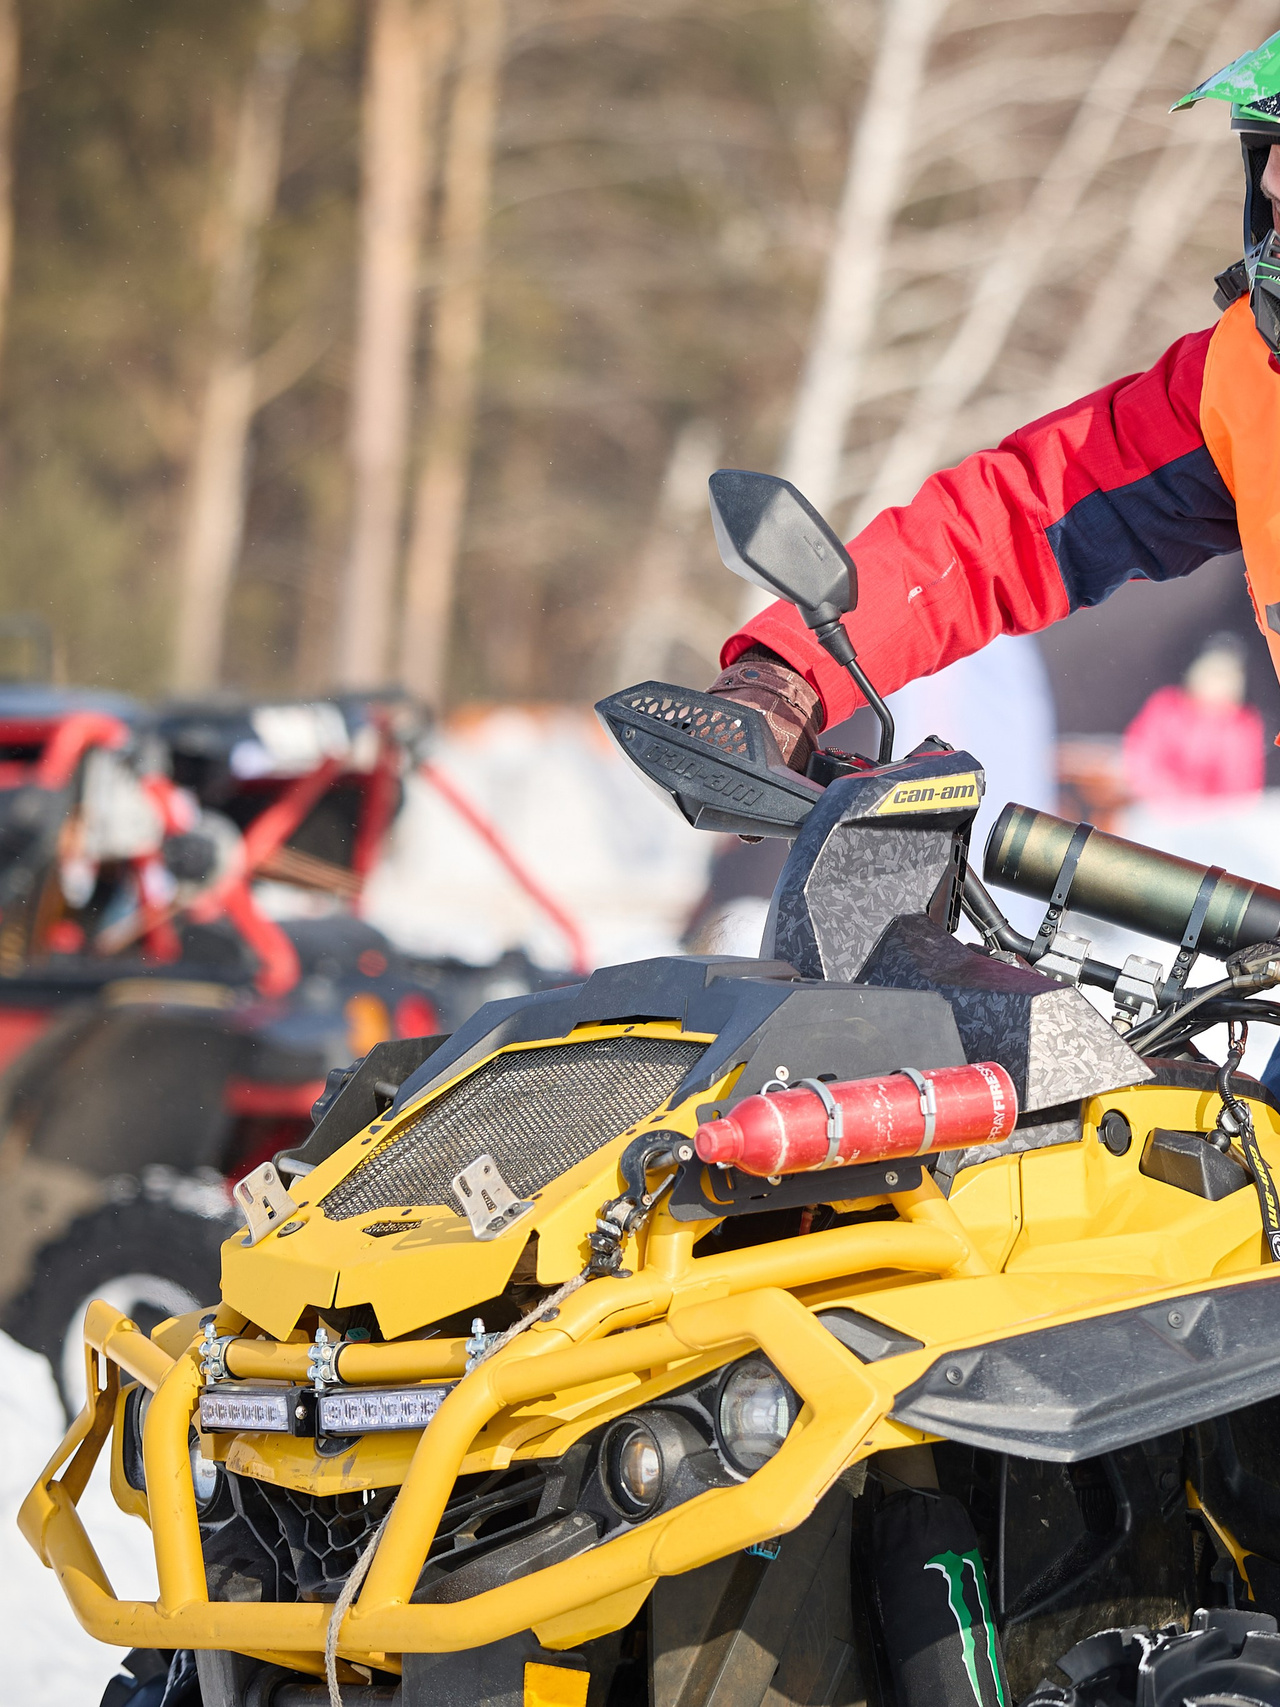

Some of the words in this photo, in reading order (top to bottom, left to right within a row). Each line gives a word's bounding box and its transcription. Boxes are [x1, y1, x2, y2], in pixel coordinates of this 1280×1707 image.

[640, 742, 764, 807] can-am
[893, 785, 975, 804] can-am
[1249, 1144, 1279, 1229] can-am
